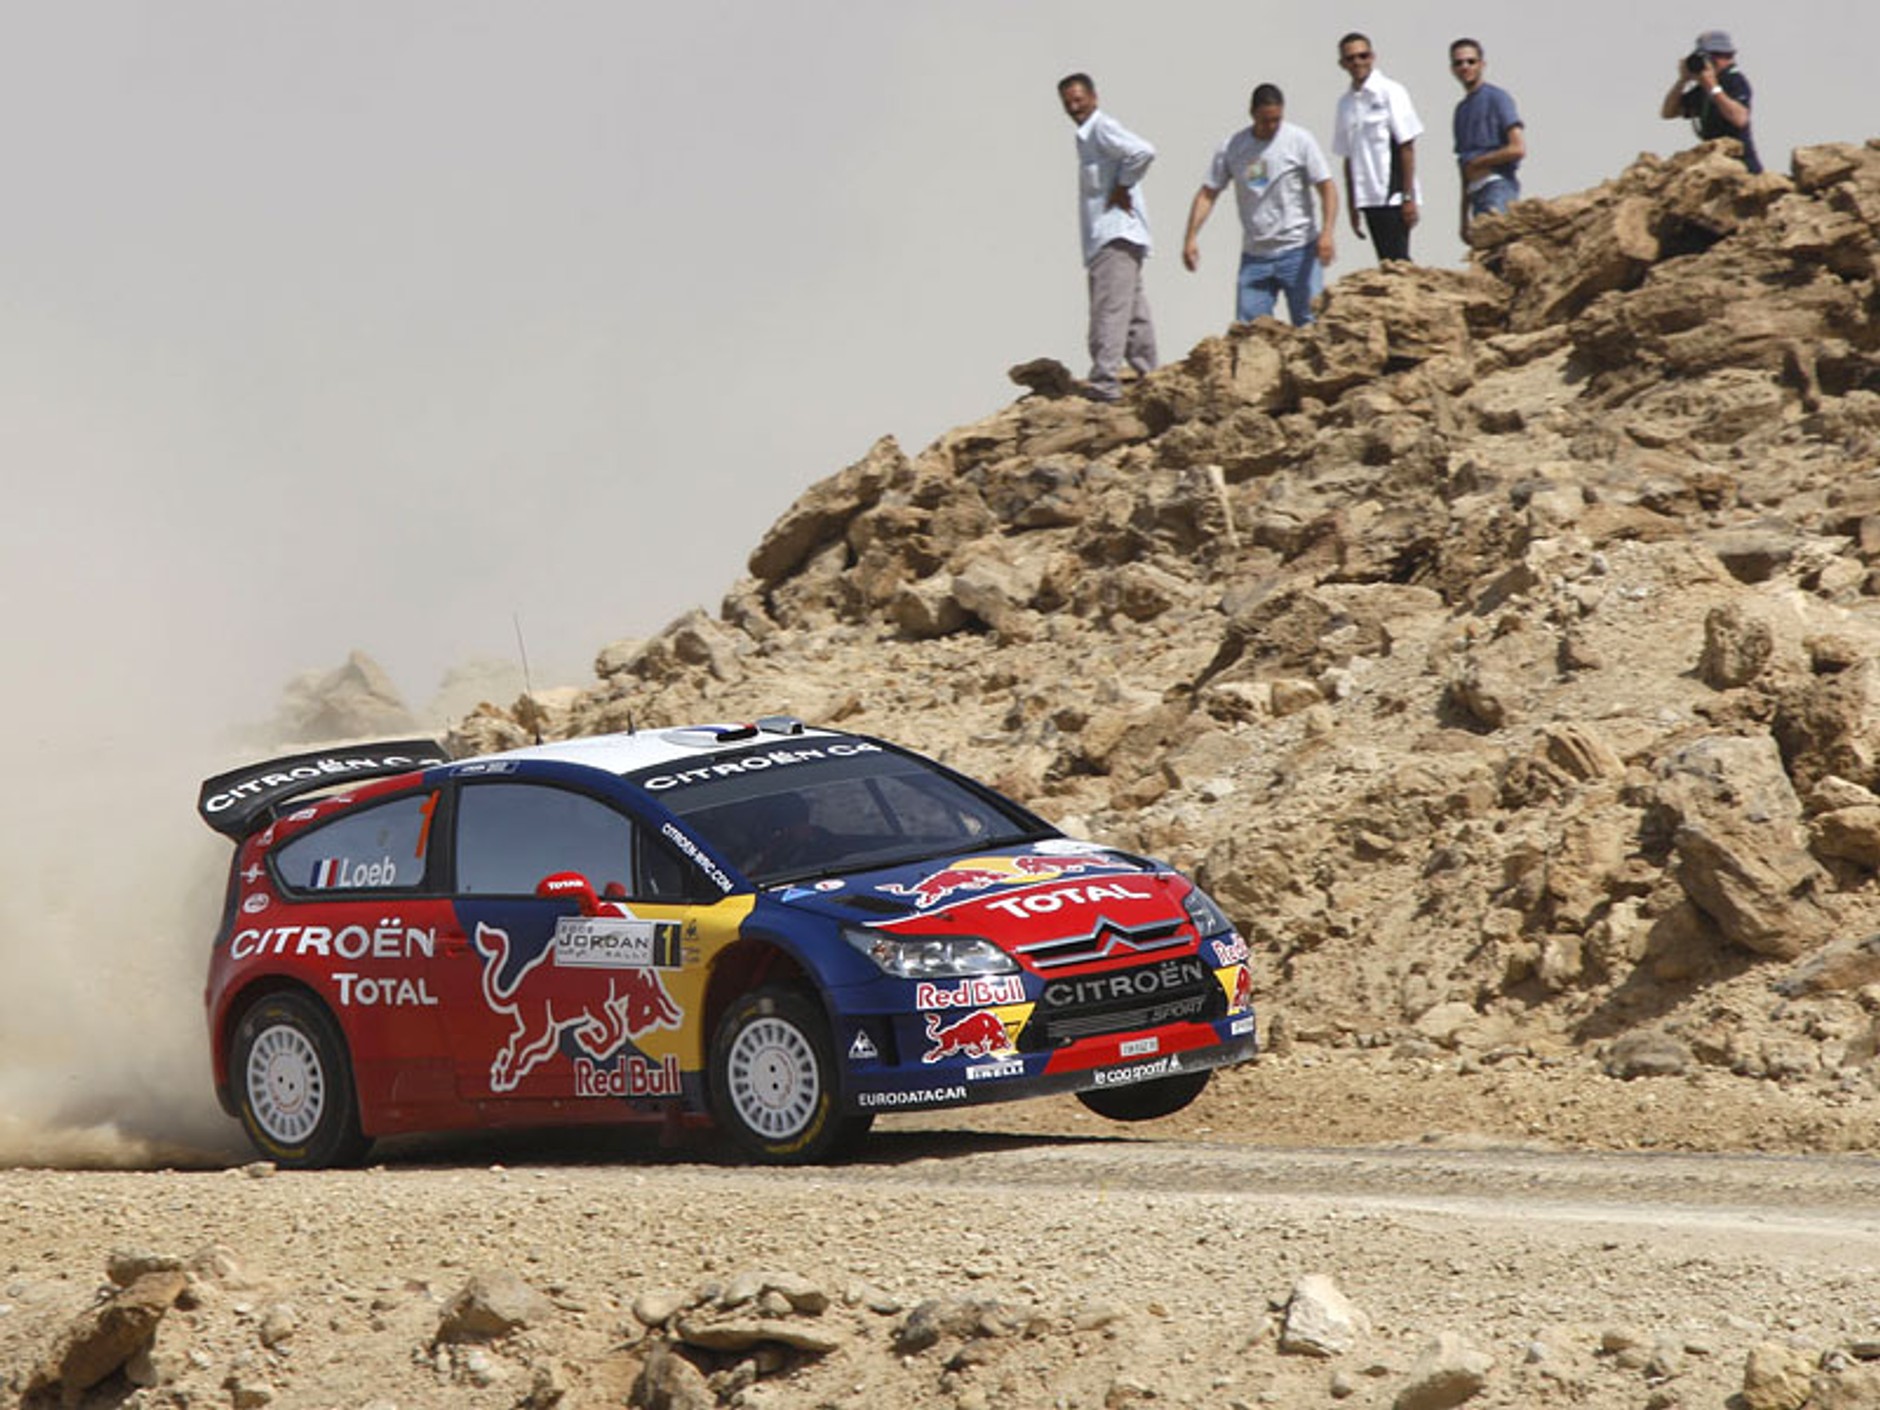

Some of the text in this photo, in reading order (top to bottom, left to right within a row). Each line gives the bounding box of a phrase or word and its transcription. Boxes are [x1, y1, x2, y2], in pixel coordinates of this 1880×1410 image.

[338, 856, 396, 887] Loeb
[986, 883, 1152, 918] TOTAL
[231, 917, 436, 960] CITROËN
[559, 932, 649, 950] JORDAN
[662, 924, 673, 966] 1
[331, 972, 438, 1005] TOTAL
[916, 974, 1026, 1010] Red Bull
[1044, 960, 1204, 1006] CITROËN
[575, 1053, 682, 1096] Red Bull
[858, 1086, 968, 1107] EURODATACAR
